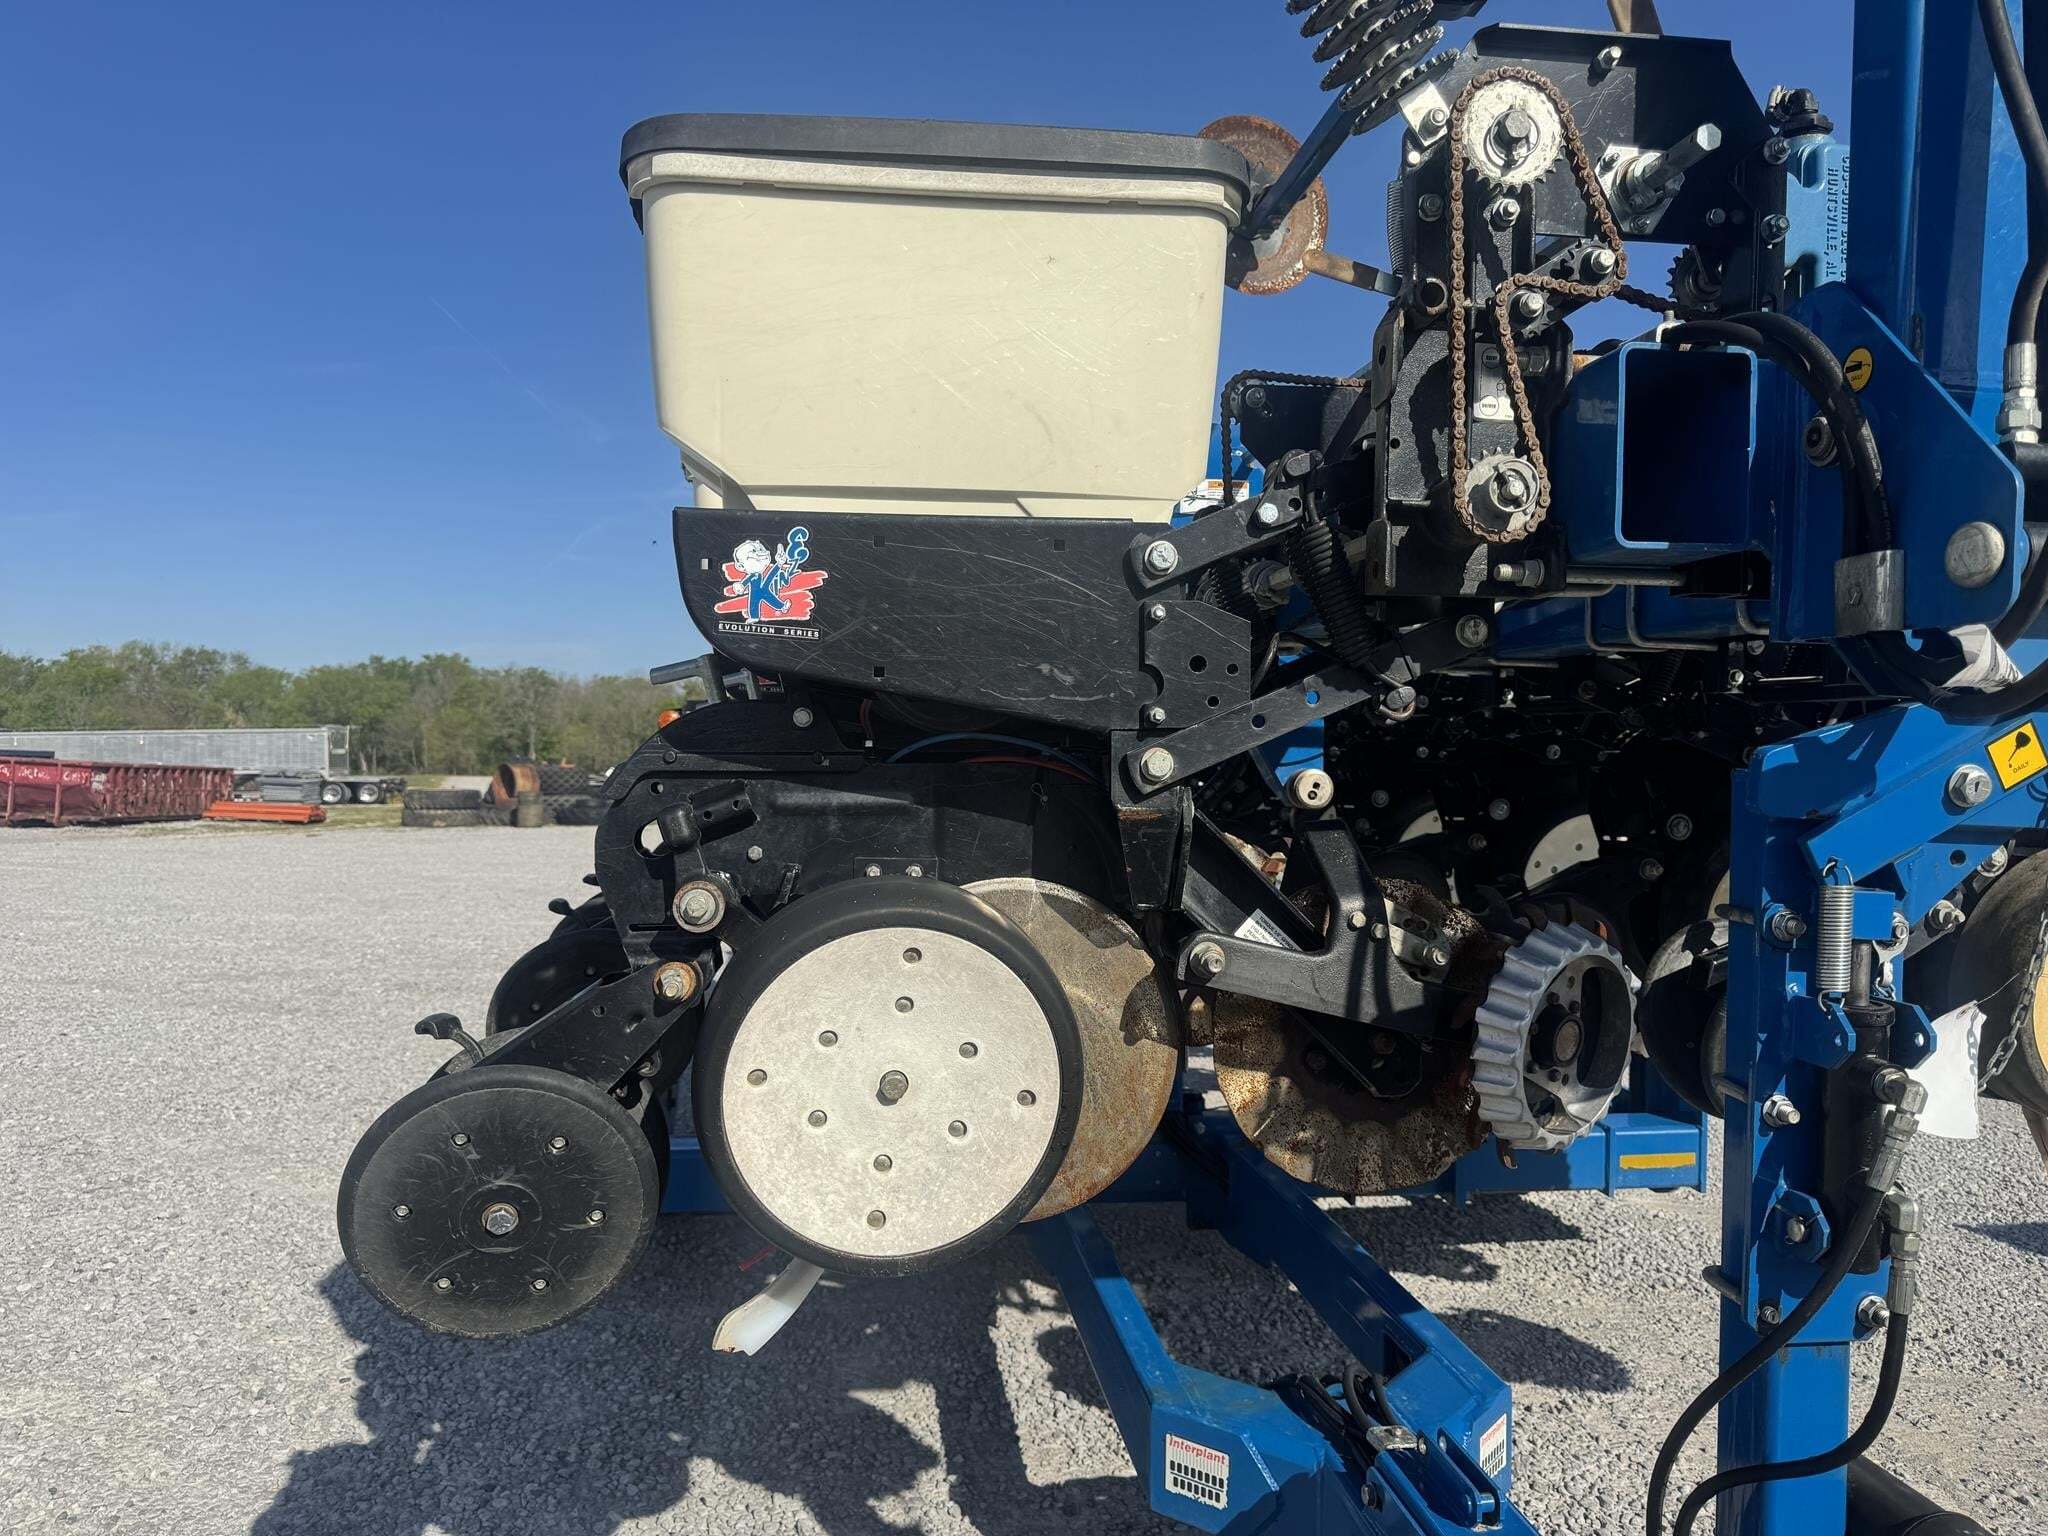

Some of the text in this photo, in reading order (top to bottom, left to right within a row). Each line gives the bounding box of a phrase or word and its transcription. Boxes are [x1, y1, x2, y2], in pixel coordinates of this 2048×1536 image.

[1824, 168, 1839, 278] HUNTSVILLE, AL
[718, 623, 820, 638] EVOLUTION SERIES
[2012, 761, 2029, 774] DAILY
[1169, 1436, 1226, 1464] Interplant
